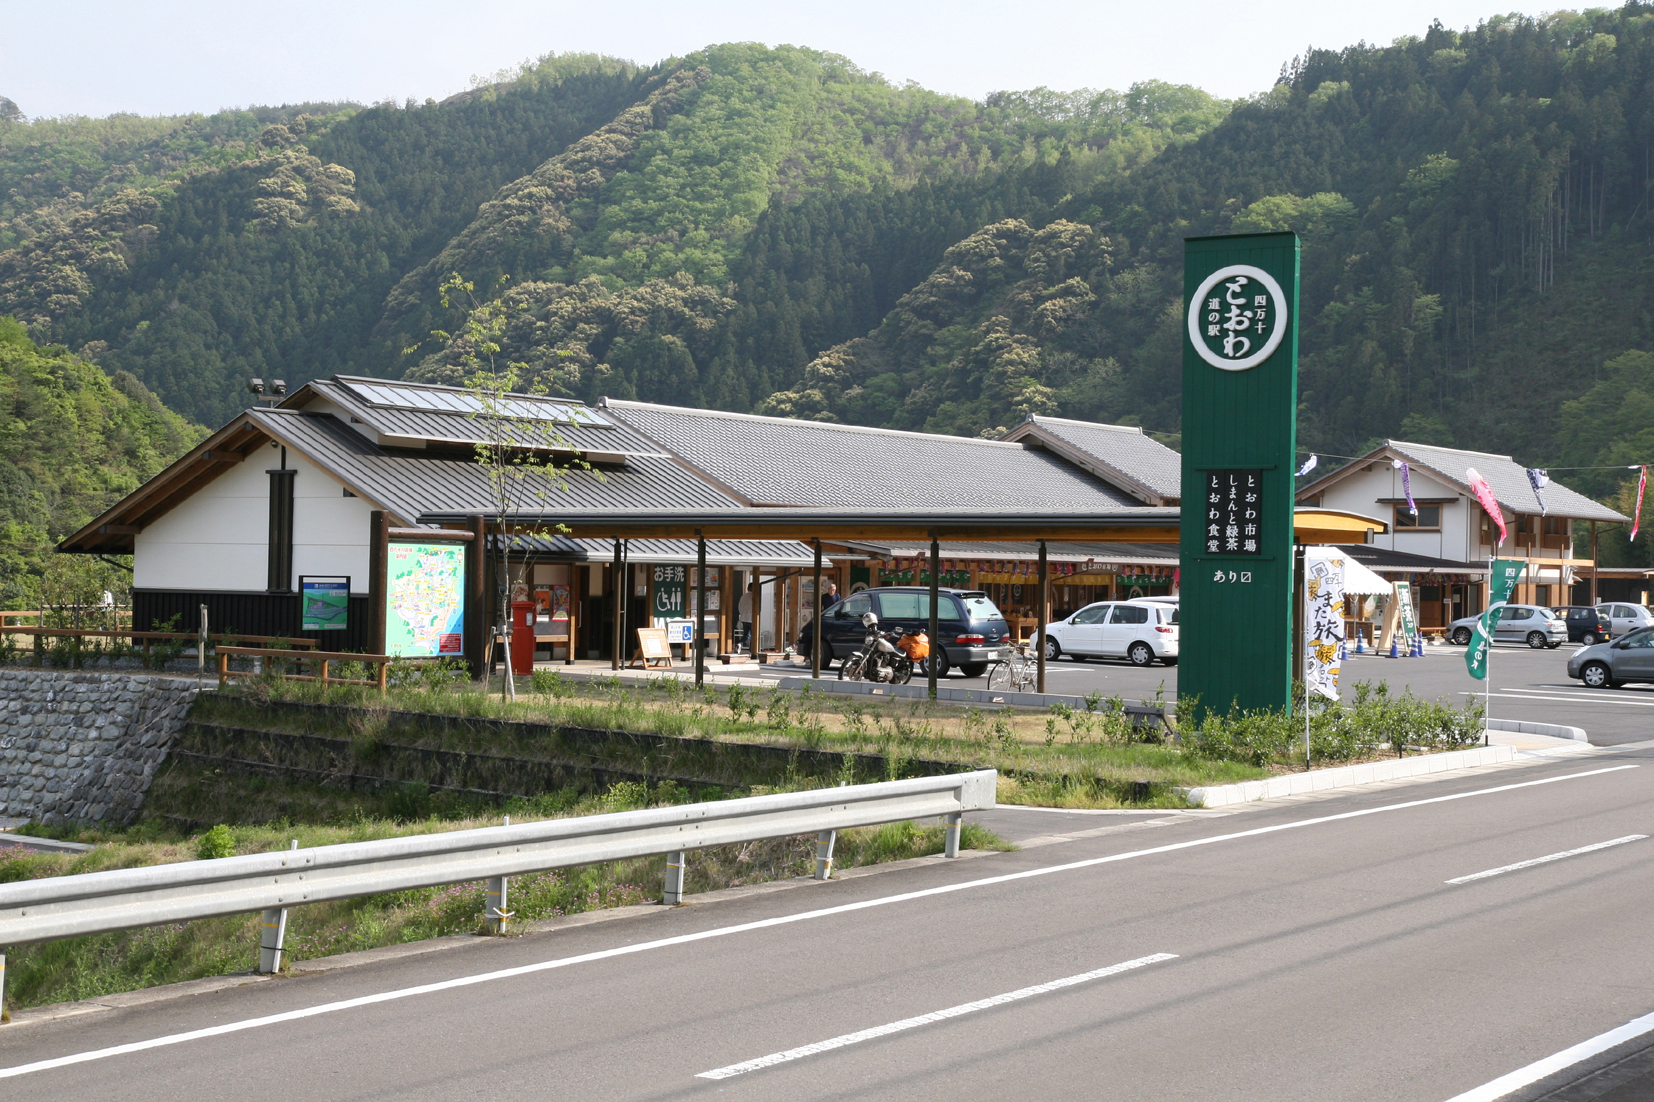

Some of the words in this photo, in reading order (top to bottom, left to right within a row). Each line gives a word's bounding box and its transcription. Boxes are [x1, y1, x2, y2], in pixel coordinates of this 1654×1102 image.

[1207, 298, 1221, 337] 道の駅
[1254, 295, 1267, 334] 四万十
[1207, 475, 1220, 553] とおわ食堂
[1225, 474, 1239, 551] しまんと緑茶
[1243, 475, 1257, 552] とおわ市場
[653, 566, 685, 582] お手洗
[1503, 568, 1516, 599] 四万十
[1313, 590, 1343, 642] また旅
